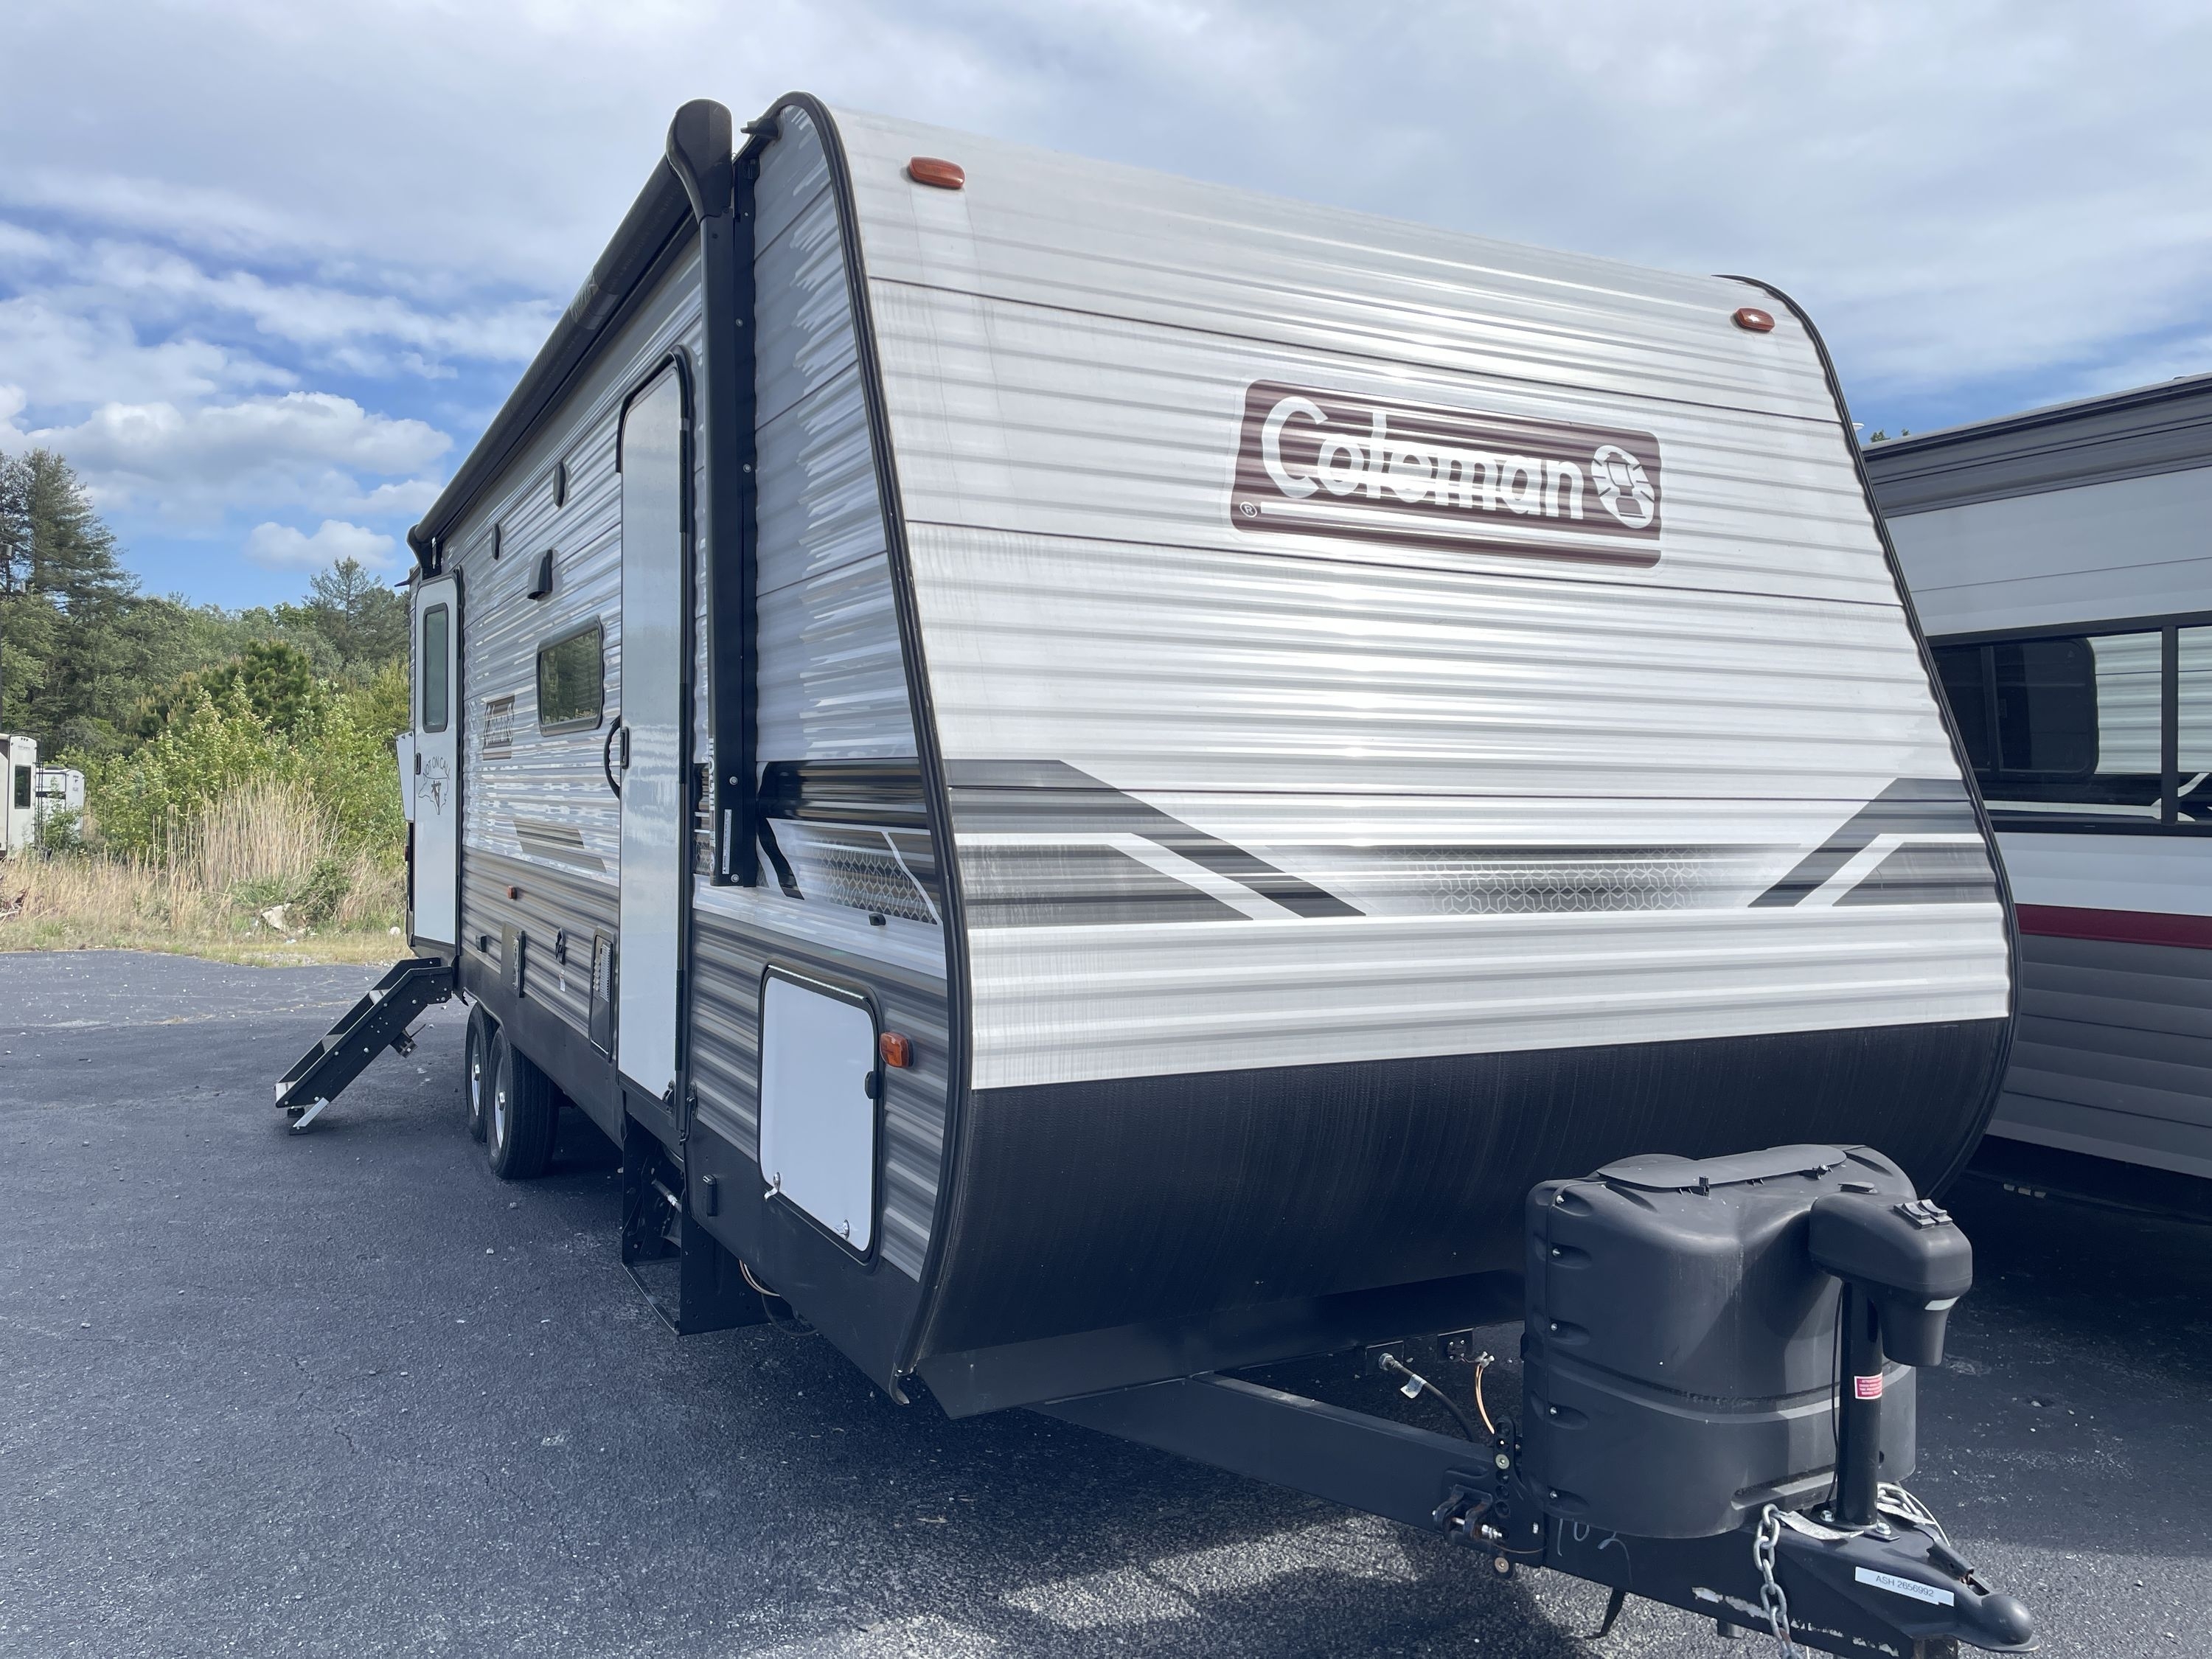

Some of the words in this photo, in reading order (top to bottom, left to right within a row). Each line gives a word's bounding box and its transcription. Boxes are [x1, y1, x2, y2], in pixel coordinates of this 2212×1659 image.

[1262, 396, 1585, 519] Coleman
[432, 756, 439, 768] ON
[1876, 1575, 1895, 1586] ASH
[1897, 1580, 1934, 1598] 2656992
